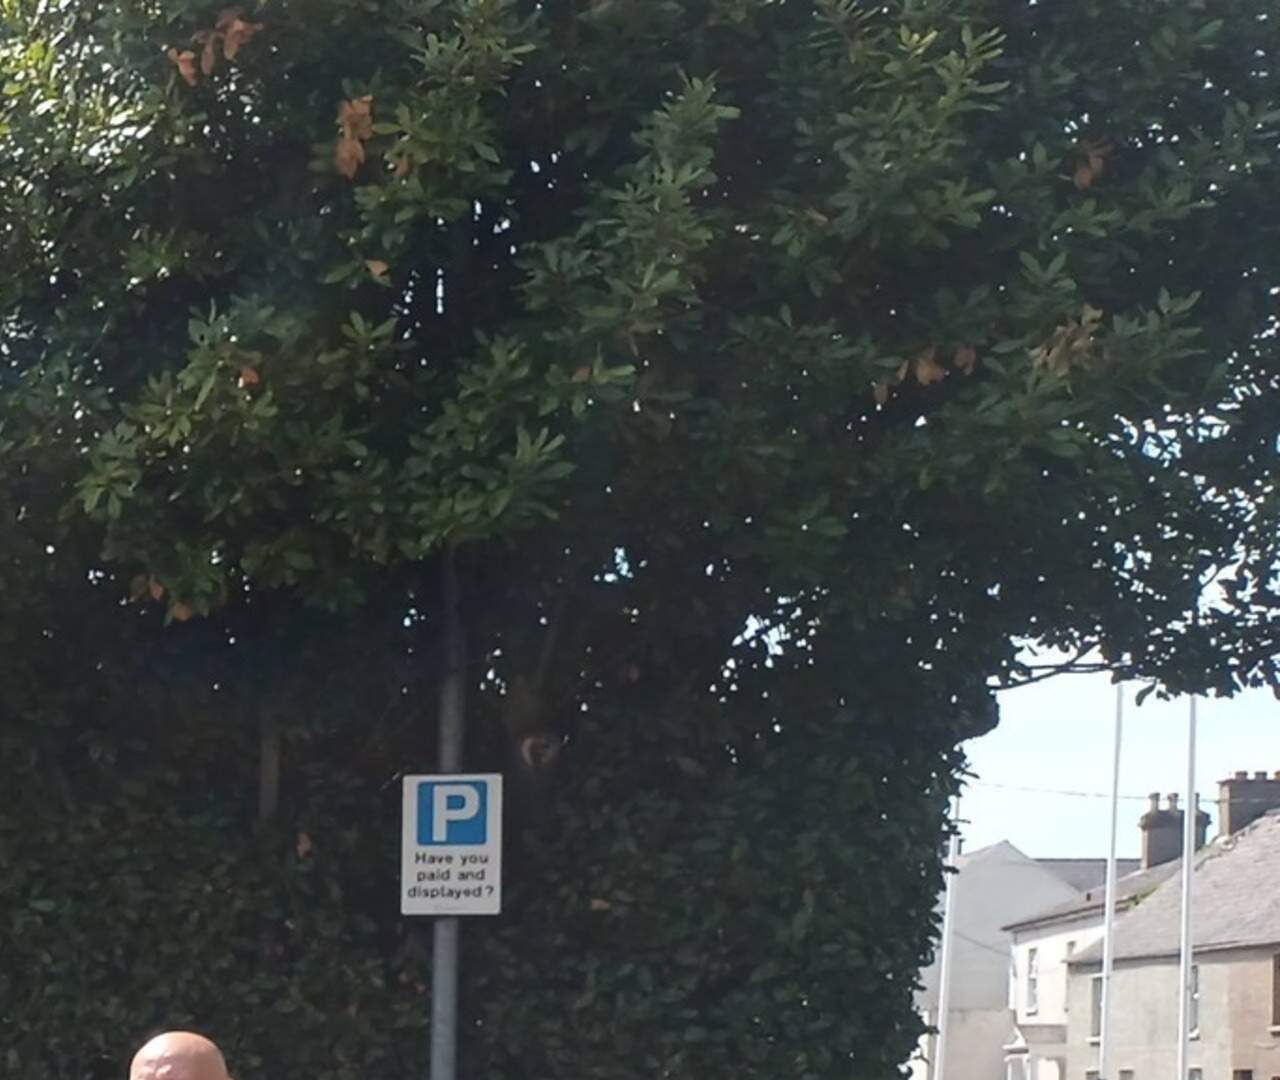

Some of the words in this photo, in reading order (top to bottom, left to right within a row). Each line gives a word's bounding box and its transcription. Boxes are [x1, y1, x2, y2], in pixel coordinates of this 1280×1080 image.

[432, 784, 480, 842] P
[414, 852, 453, 865] Have
[460, 854, 489, 866] you
[416, 869, 451, 882] paid
[457, 869, 486, 881] and
